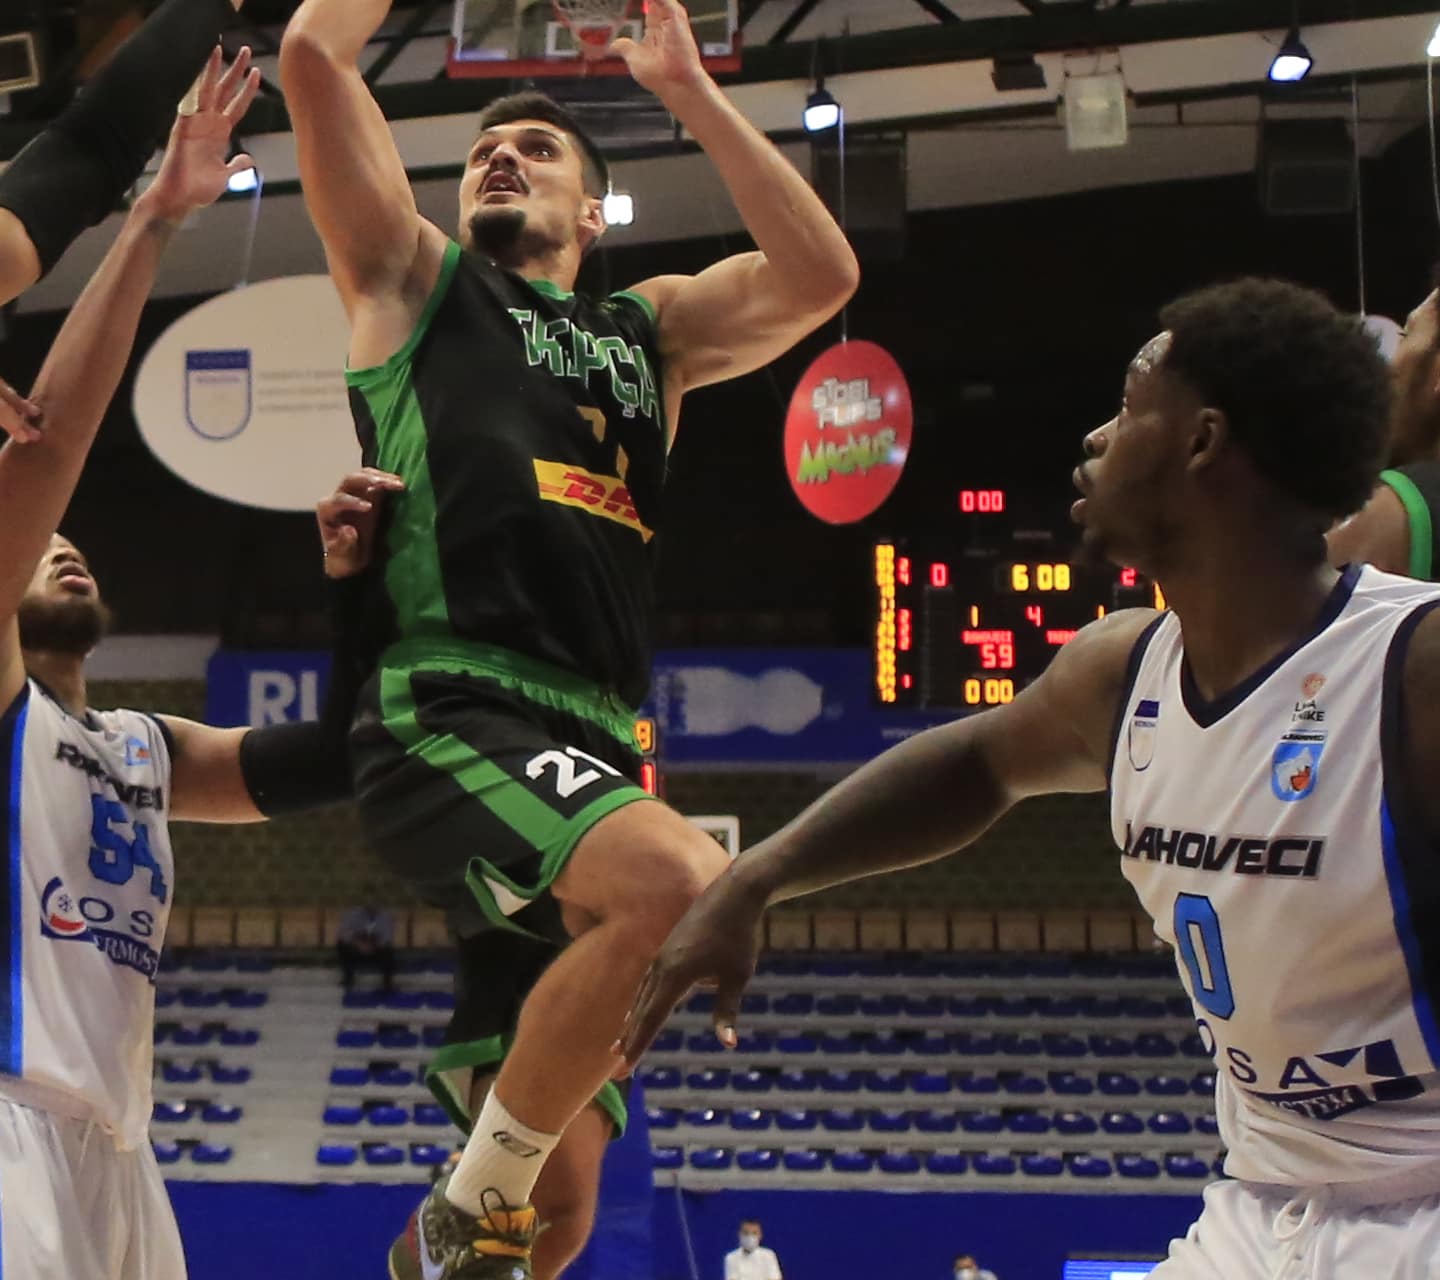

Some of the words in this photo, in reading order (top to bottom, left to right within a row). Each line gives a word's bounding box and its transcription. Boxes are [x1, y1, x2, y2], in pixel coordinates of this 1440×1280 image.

[930, 563, 948, 587] 0
[970, 605, 979, 629] 1
[1025, 605, 1042, 627] 4
[981, 643, 1014, 669] 59
[1174, 891, 1236, 1020] 0
